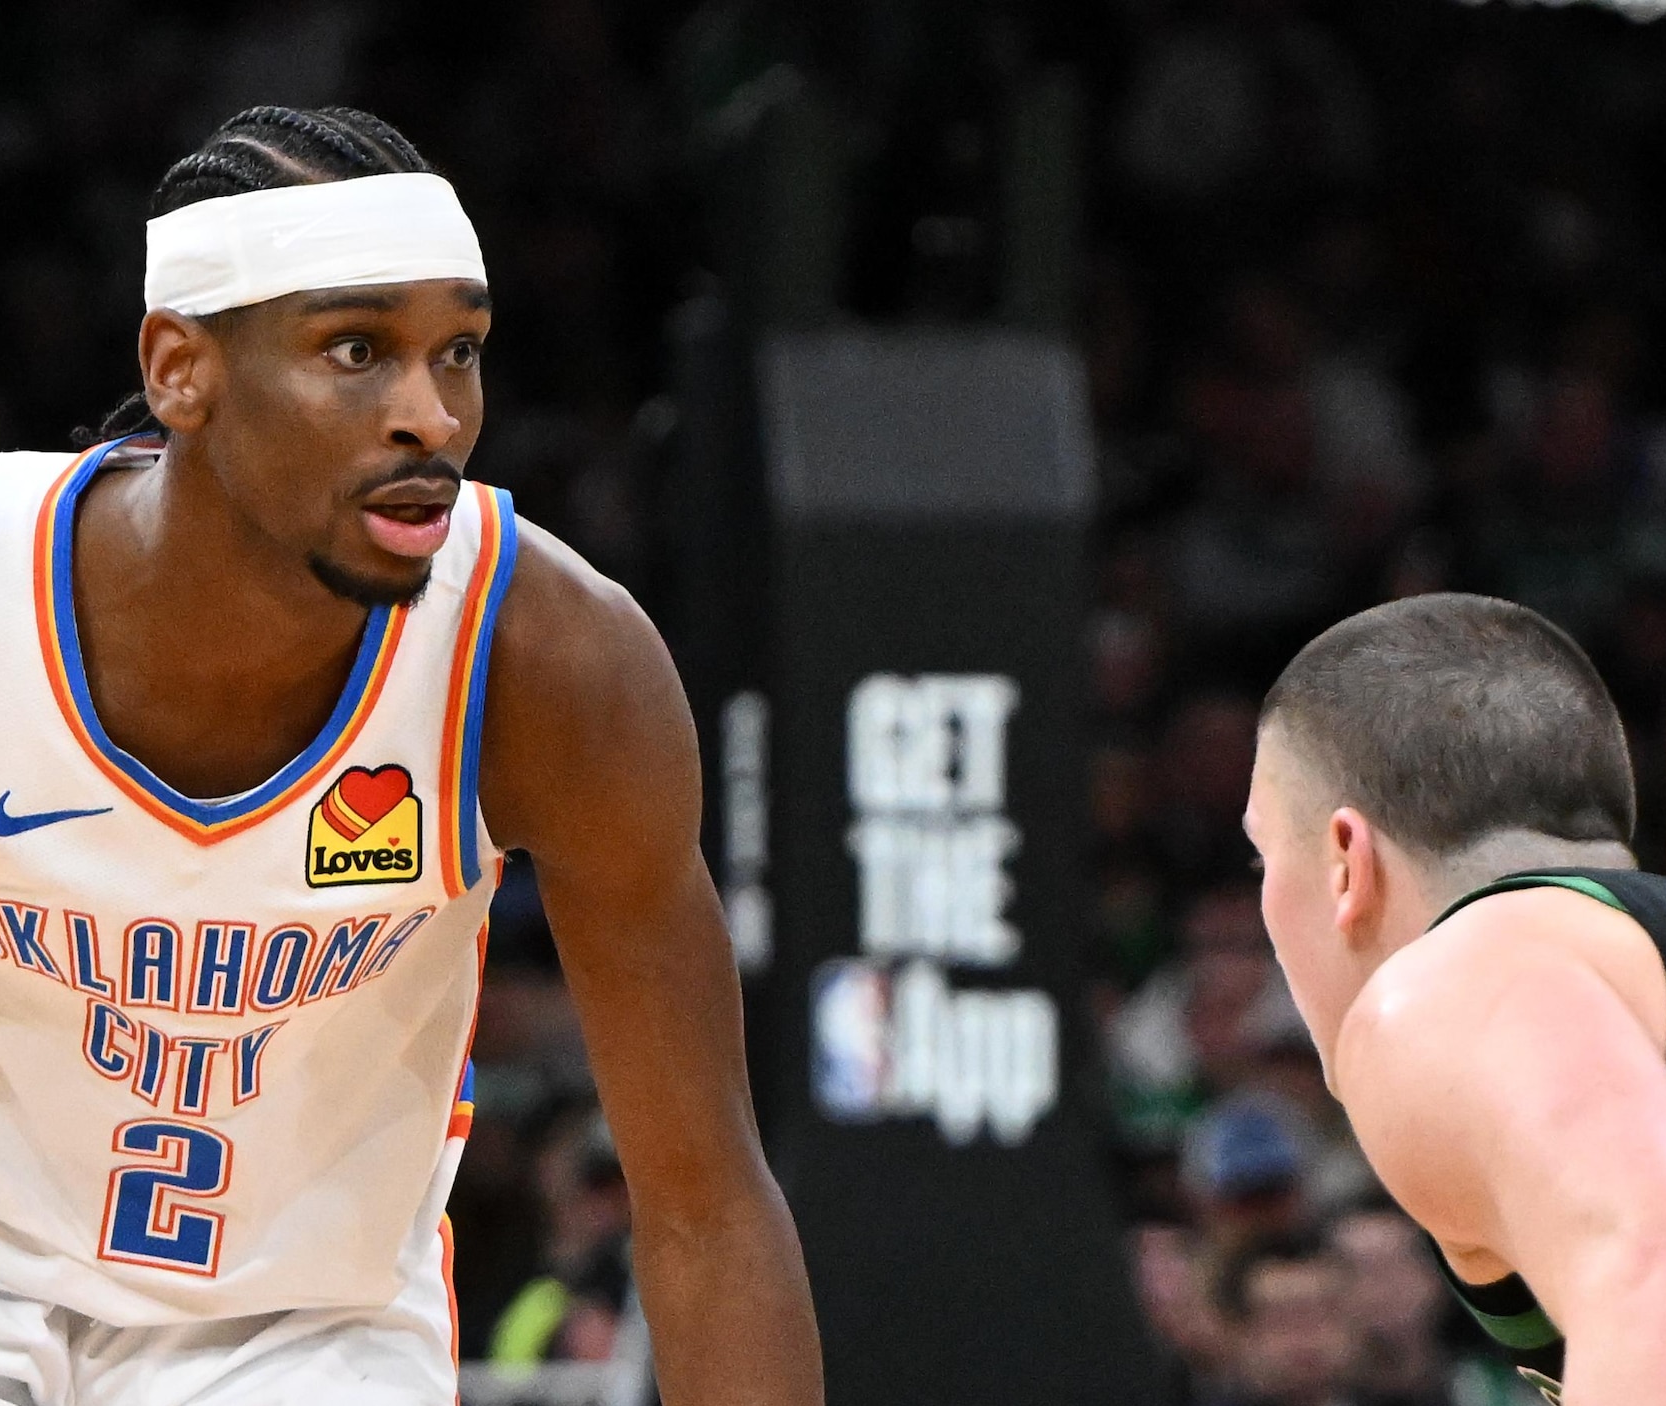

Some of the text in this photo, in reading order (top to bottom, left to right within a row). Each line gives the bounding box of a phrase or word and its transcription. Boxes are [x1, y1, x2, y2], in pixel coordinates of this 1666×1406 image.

[846, 671, 1023, 808] GET
[842, 817, 1025, 967] THE
[82, 998, 289, 1117] CITY
[889, 956, 1061, 1147] App
[97, 1116, 233, 1278] 2
